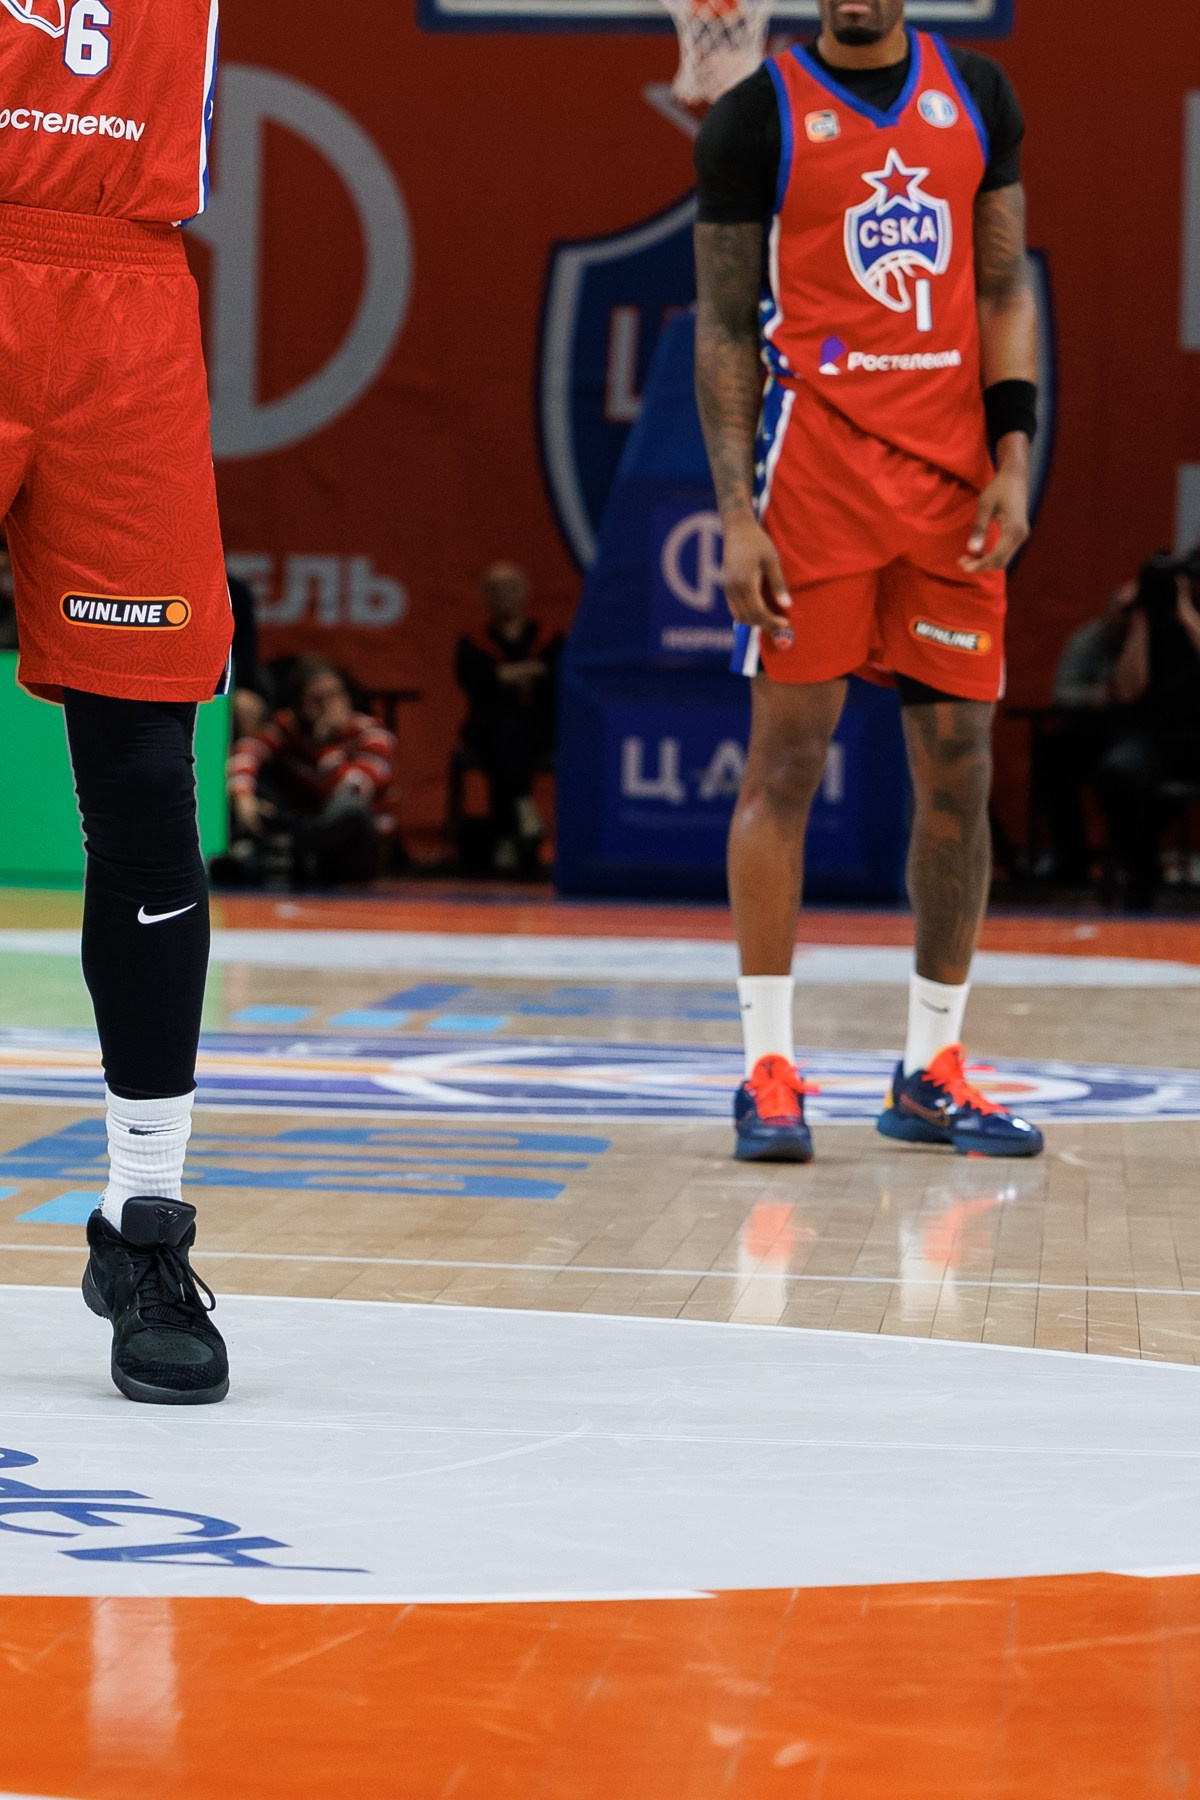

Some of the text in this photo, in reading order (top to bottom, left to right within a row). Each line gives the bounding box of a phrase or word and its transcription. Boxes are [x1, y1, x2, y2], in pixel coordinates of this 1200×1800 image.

[858, 214, 938, 249] CSKA
[915, 278, 932, 332] 1
[69, 599, 163, 623] WINLINE
